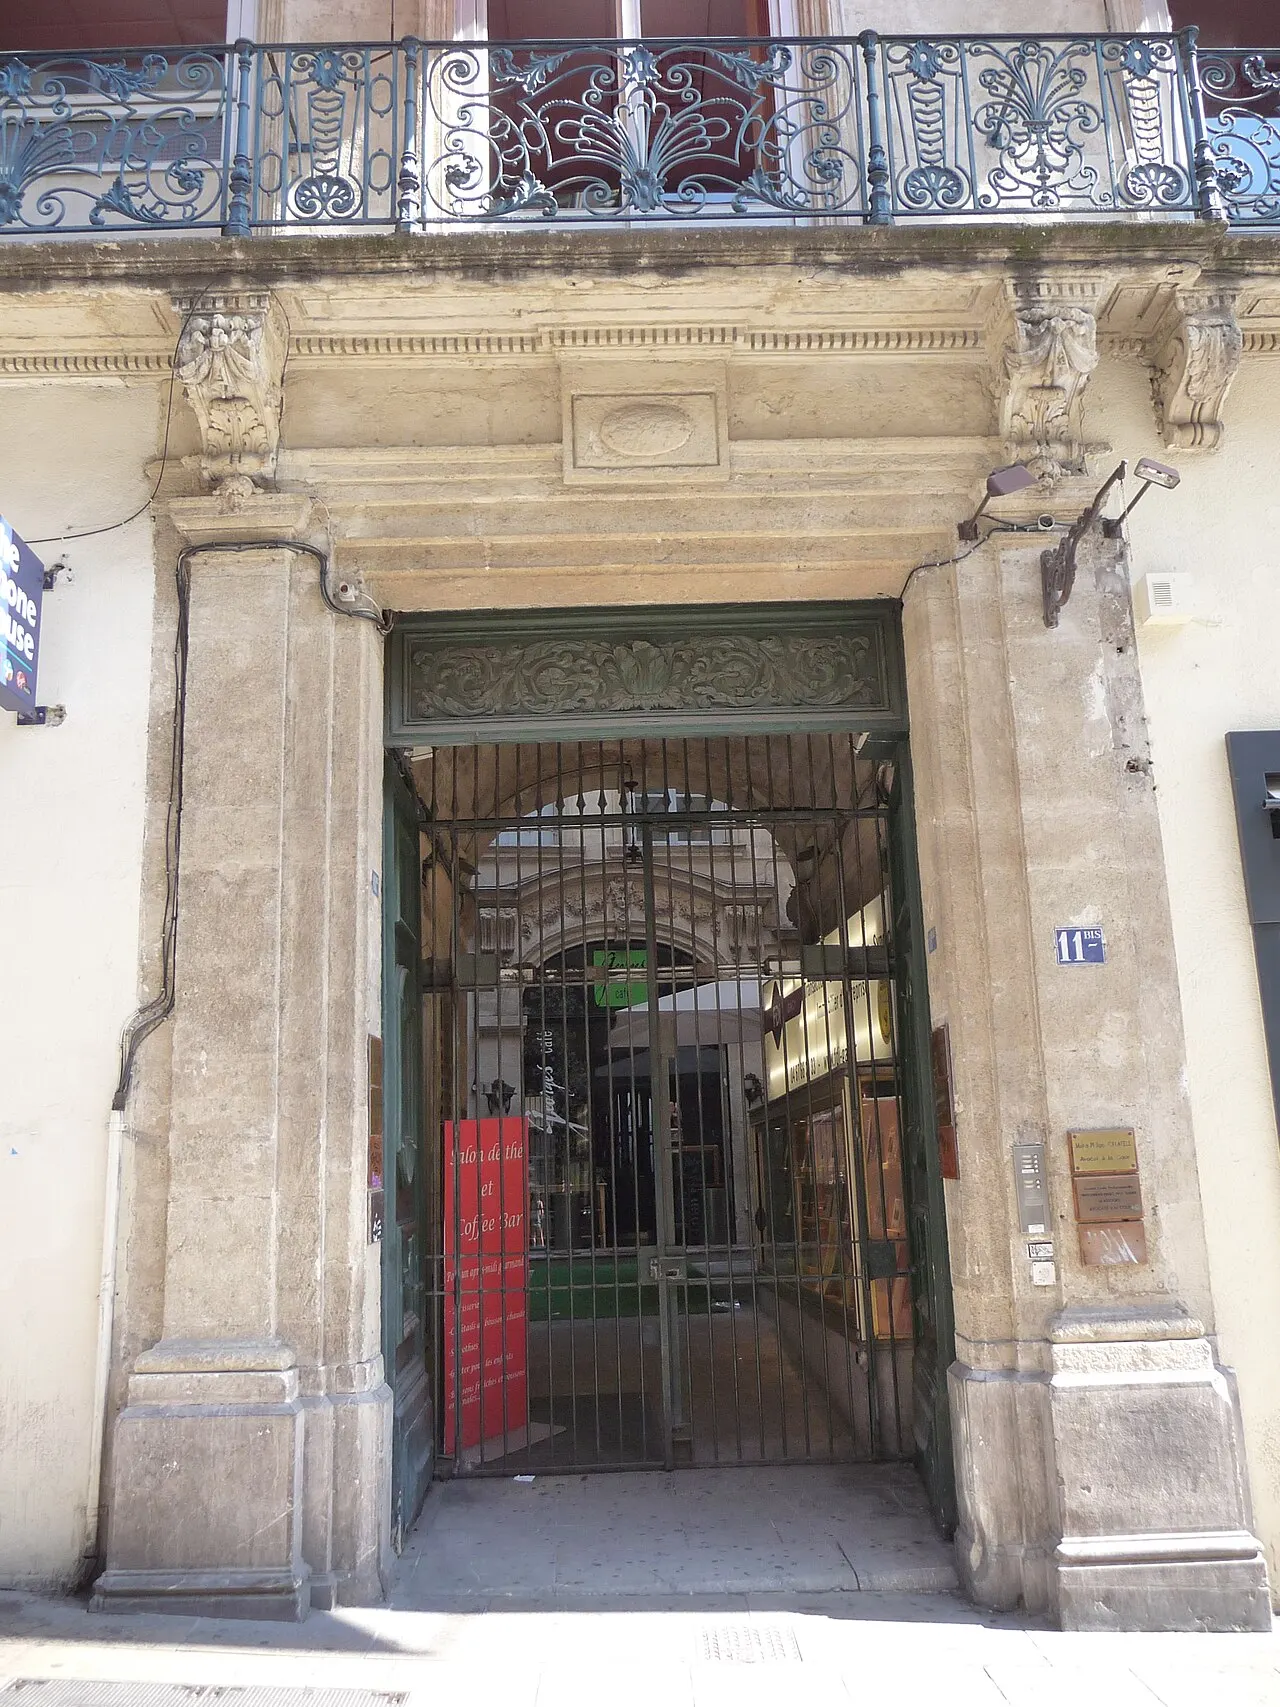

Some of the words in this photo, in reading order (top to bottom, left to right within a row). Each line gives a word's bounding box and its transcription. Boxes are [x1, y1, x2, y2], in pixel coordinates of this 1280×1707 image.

[1058, 931, 1085, 961] 11
[1083, 930, 1101, 940] BIS
[488, 1142, 500, 1161] de
[505, 1140, 523, 1159] thé
[481, 1180, 493, 1196] et
[499, 1212, 523, 1229] Bar
